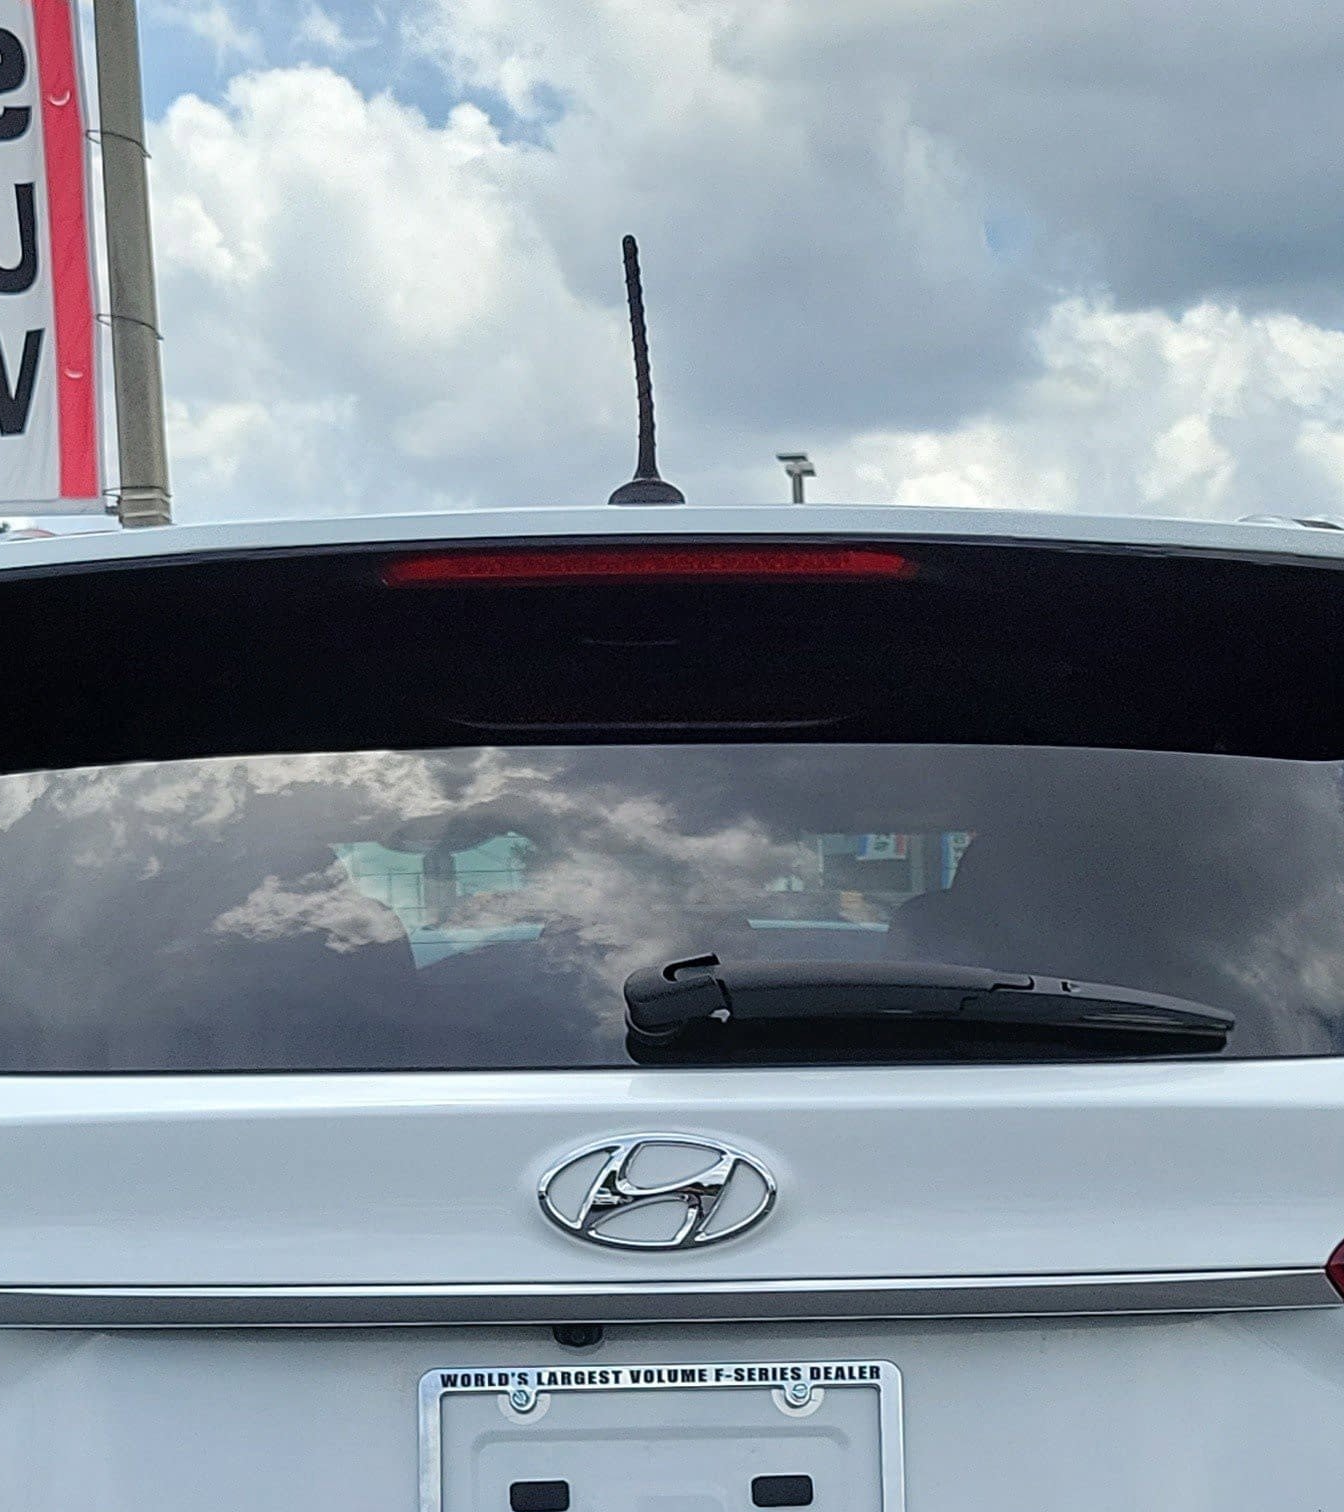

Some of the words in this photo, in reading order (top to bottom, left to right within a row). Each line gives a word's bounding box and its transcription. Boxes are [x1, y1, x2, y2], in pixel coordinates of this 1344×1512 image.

[440, 1372, 529, 1388] WORLD'S
[537, 1370, 623, 1386] LARGEST
[630, 1368, 706, 1384] VOLUME
[714, 1366, 802, 1382] F-SERIES
[810, 1365, 881, 1381] DEALER
